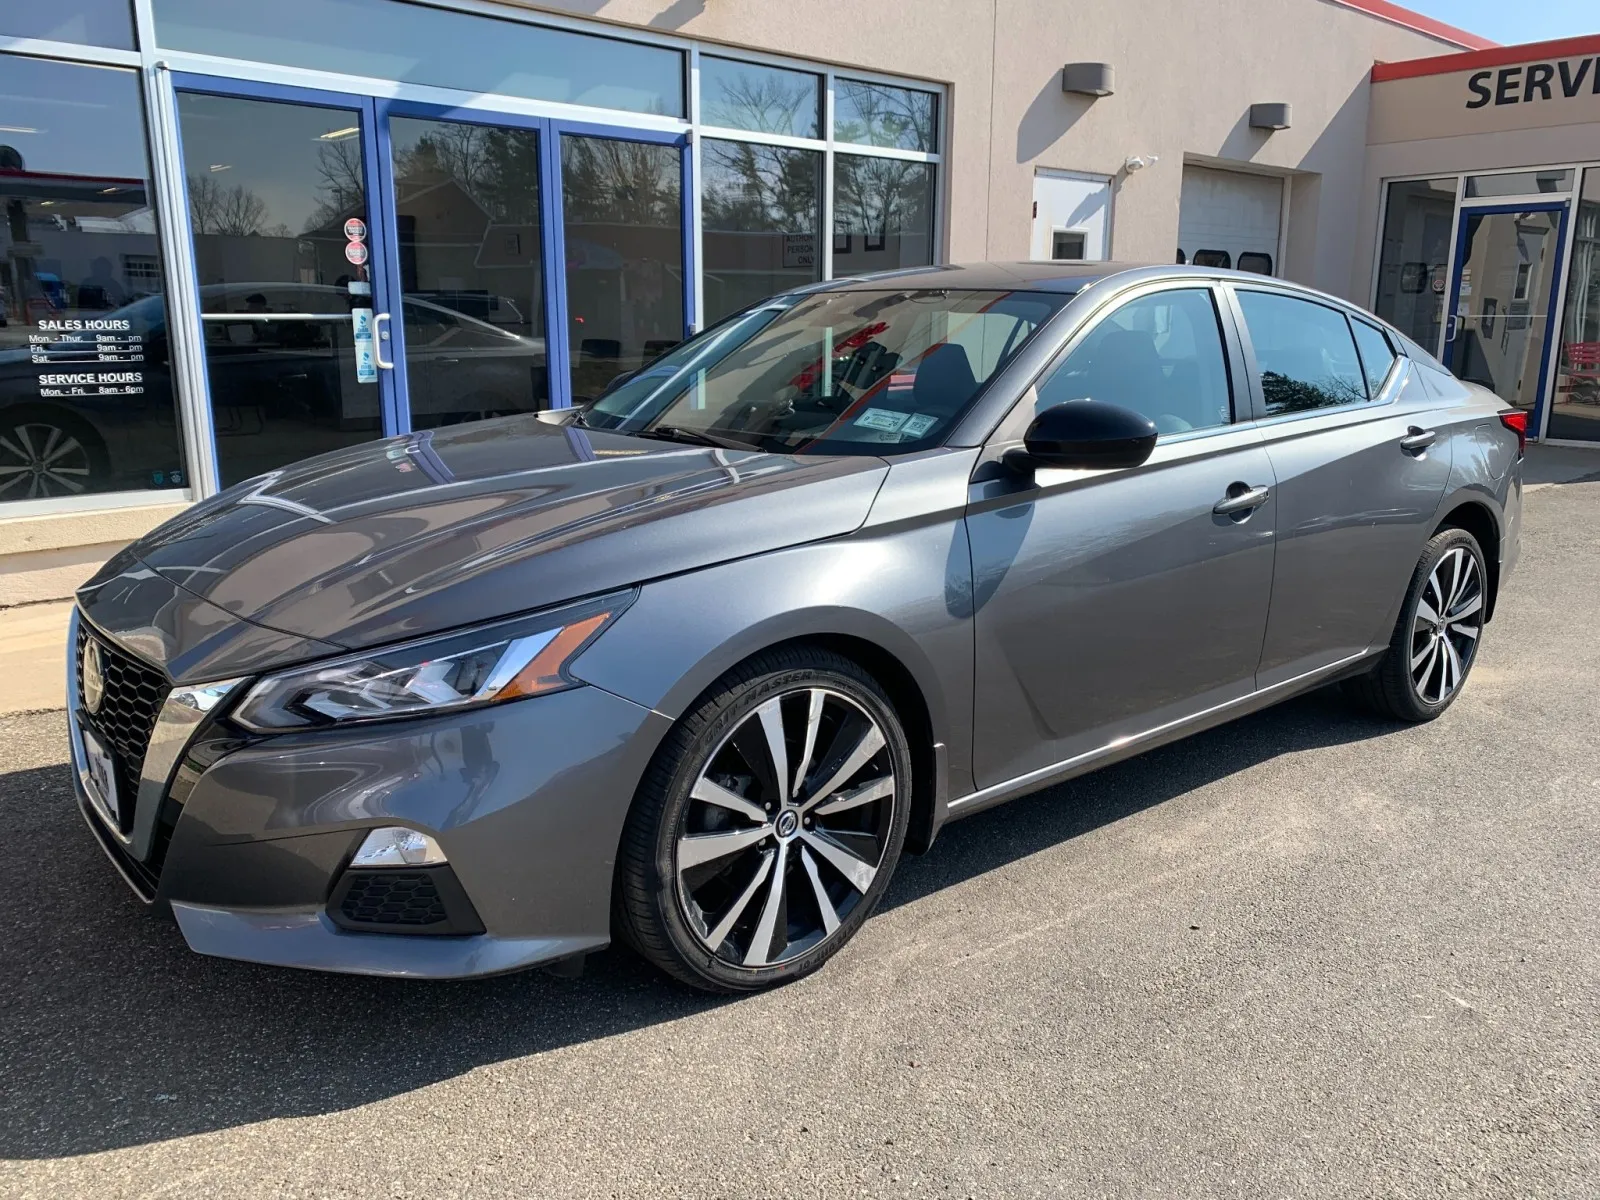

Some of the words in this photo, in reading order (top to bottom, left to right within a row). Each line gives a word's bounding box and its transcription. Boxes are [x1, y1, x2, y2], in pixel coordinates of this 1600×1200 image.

[38, 320, 82, 330] SALES
[85, 320, 130, 330] HOURS
[29, 334, 52, 343] Mon.
[60, 334, 83, 342] Thur.
[96, 334, 115, 342] 9am
[128, 335, 142, 343] pm
[30, 344, 45, 353] Fri.
[97, 343, 116, 351] 9am
[129, 344, 143, 352] pm
[32, 354, 50, 363] Sat.
[98, 353, 118, 361] 9am
[130, 354, 144, 362] pm
[39, 373, 95, 384] SERVICE
[98, 372, 142, 382] HOURS
[40, 388, 63, 396] Mon.
[71, 386, 86, 395] Fri.
[98, 386, 118, 394] 8am
[125, 385, 144, 394] 6pm
